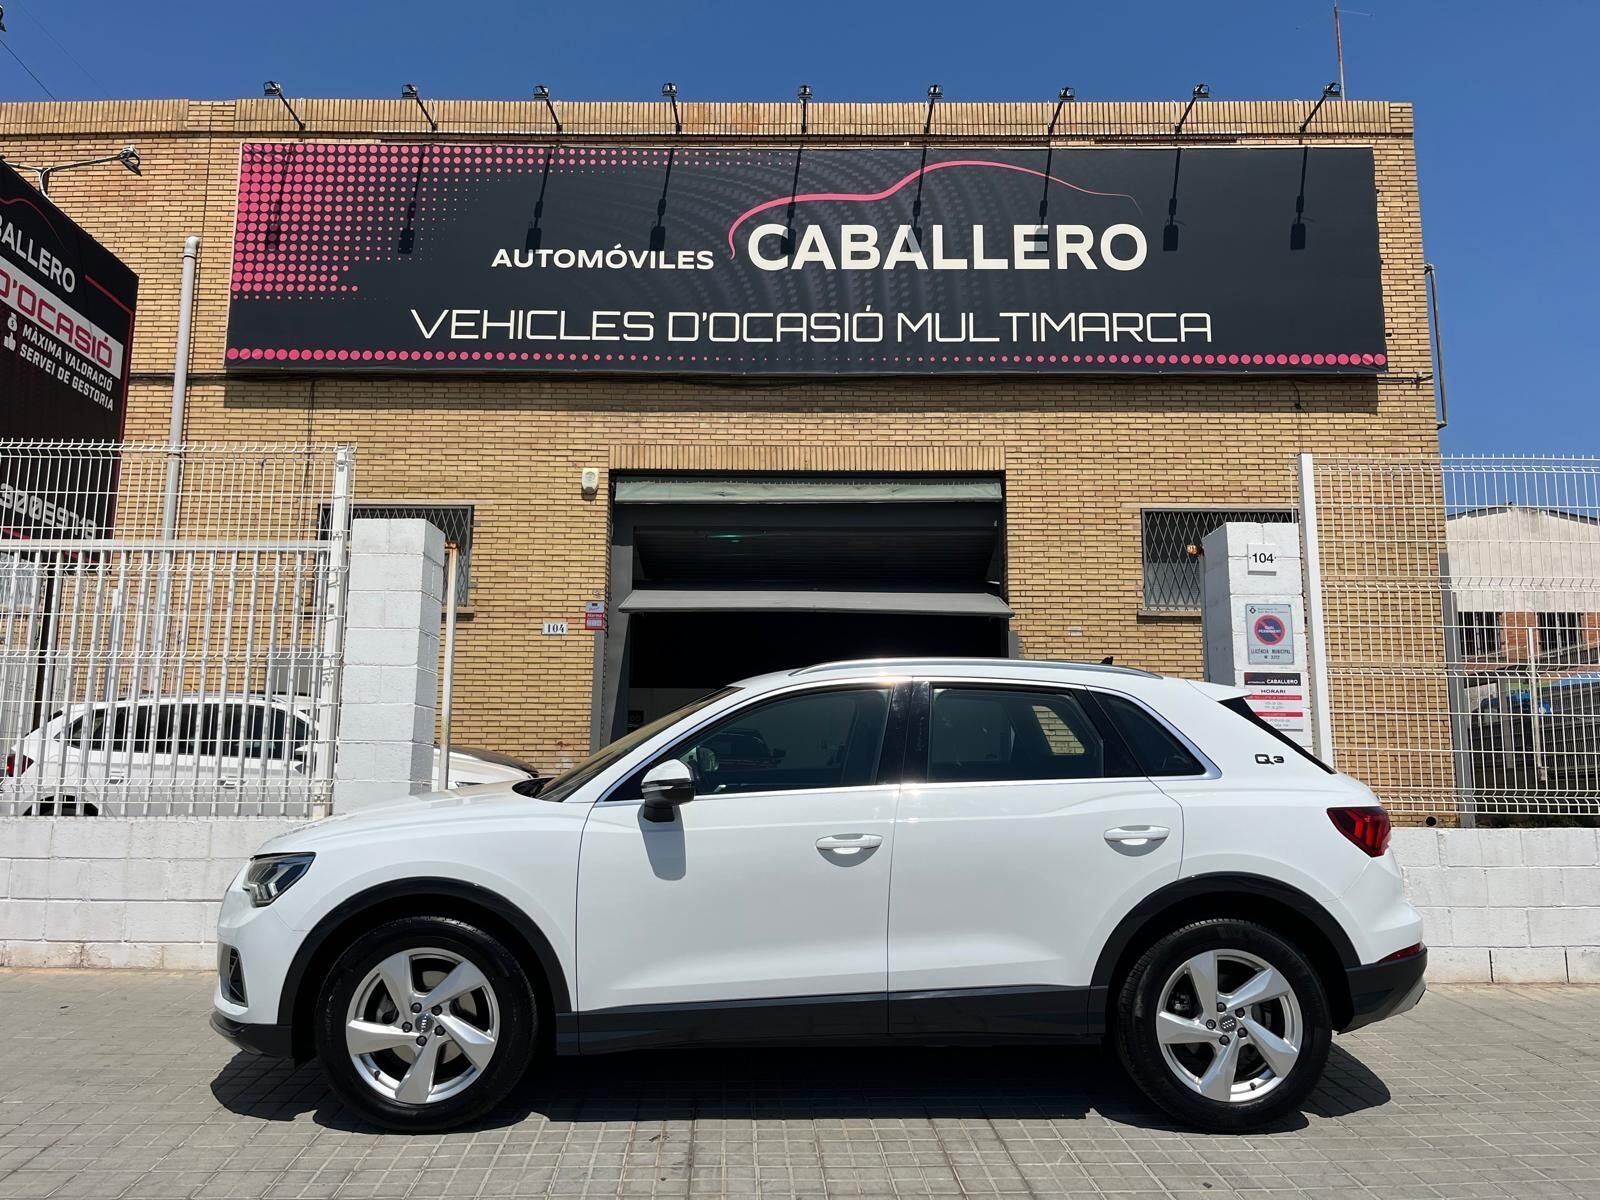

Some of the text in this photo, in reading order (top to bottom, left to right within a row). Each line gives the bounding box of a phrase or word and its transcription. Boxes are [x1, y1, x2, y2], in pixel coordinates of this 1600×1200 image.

[0, 214, 76, 293] ALLERO
[491, 223, 1148, 271] AUTOMÓVILES CABALLERO
[410, 304, 1212, 343] VEHICLES D'OCASIÓ MULTIMARCA
[20, 344, 114, 411] SERVEI DE GESTORIA
[22, 324, 113, 392] MÀXIMA VALORACIÓ
[1252, 553, 1274, 563] 104
[547, 623, 565, 633] 104
[1255, 754, 1284, 765] Q3
